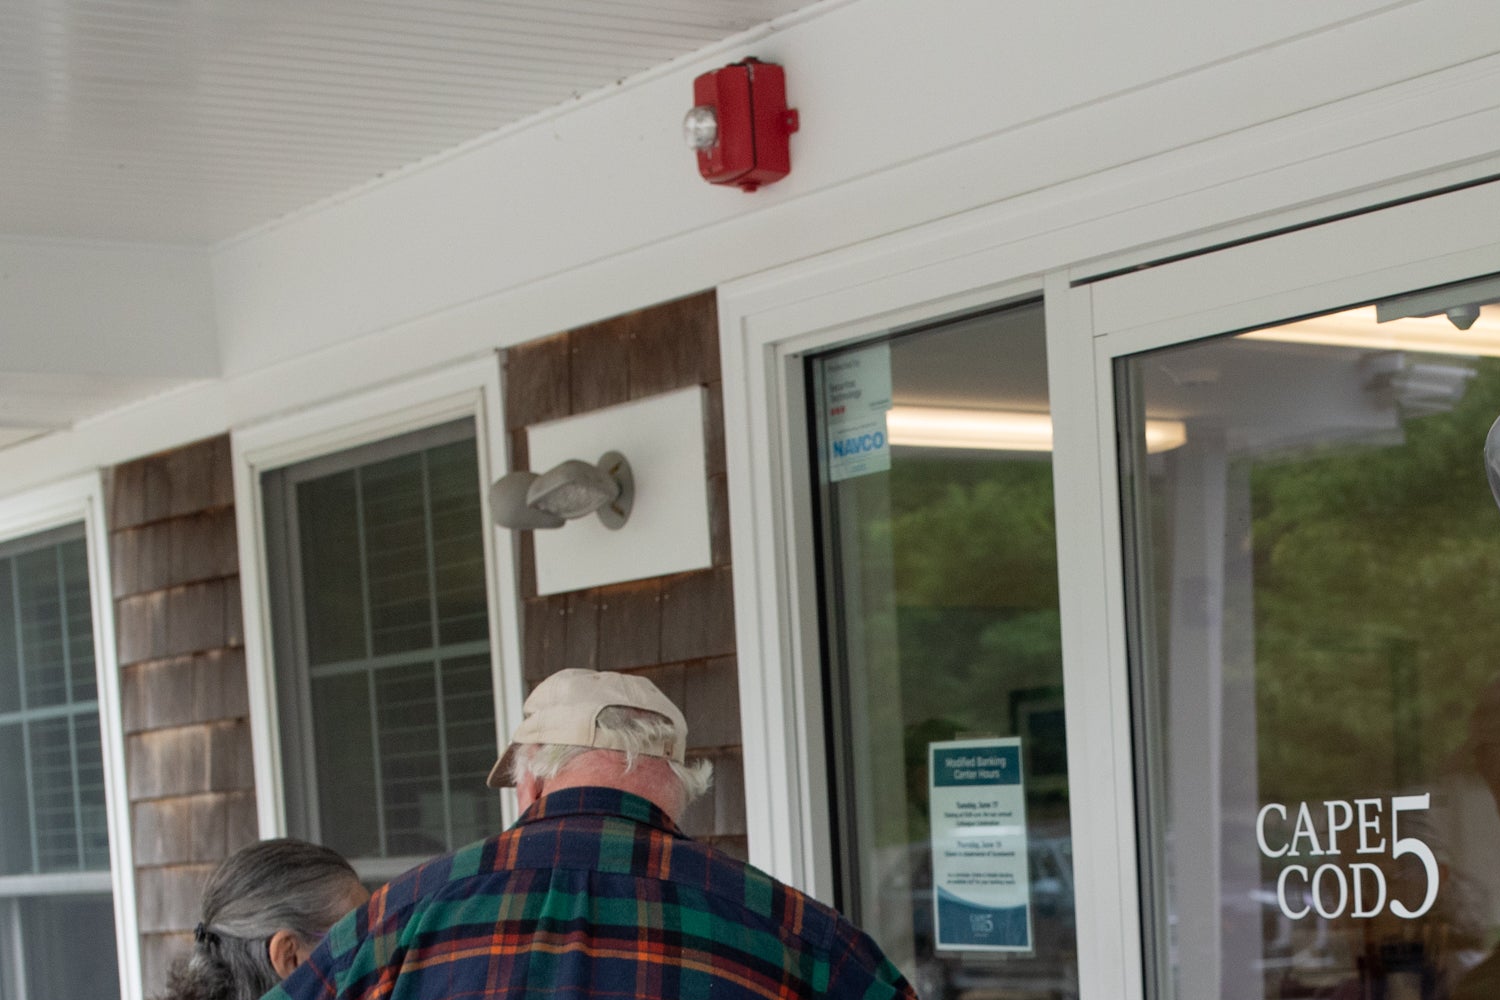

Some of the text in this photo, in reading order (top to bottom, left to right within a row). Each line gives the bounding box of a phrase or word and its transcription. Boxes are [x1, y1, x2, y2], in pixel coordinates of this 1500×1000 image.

[1256, 792, 1439, 919] CAPE 5
[1277, 863, 1387, 920] COD
